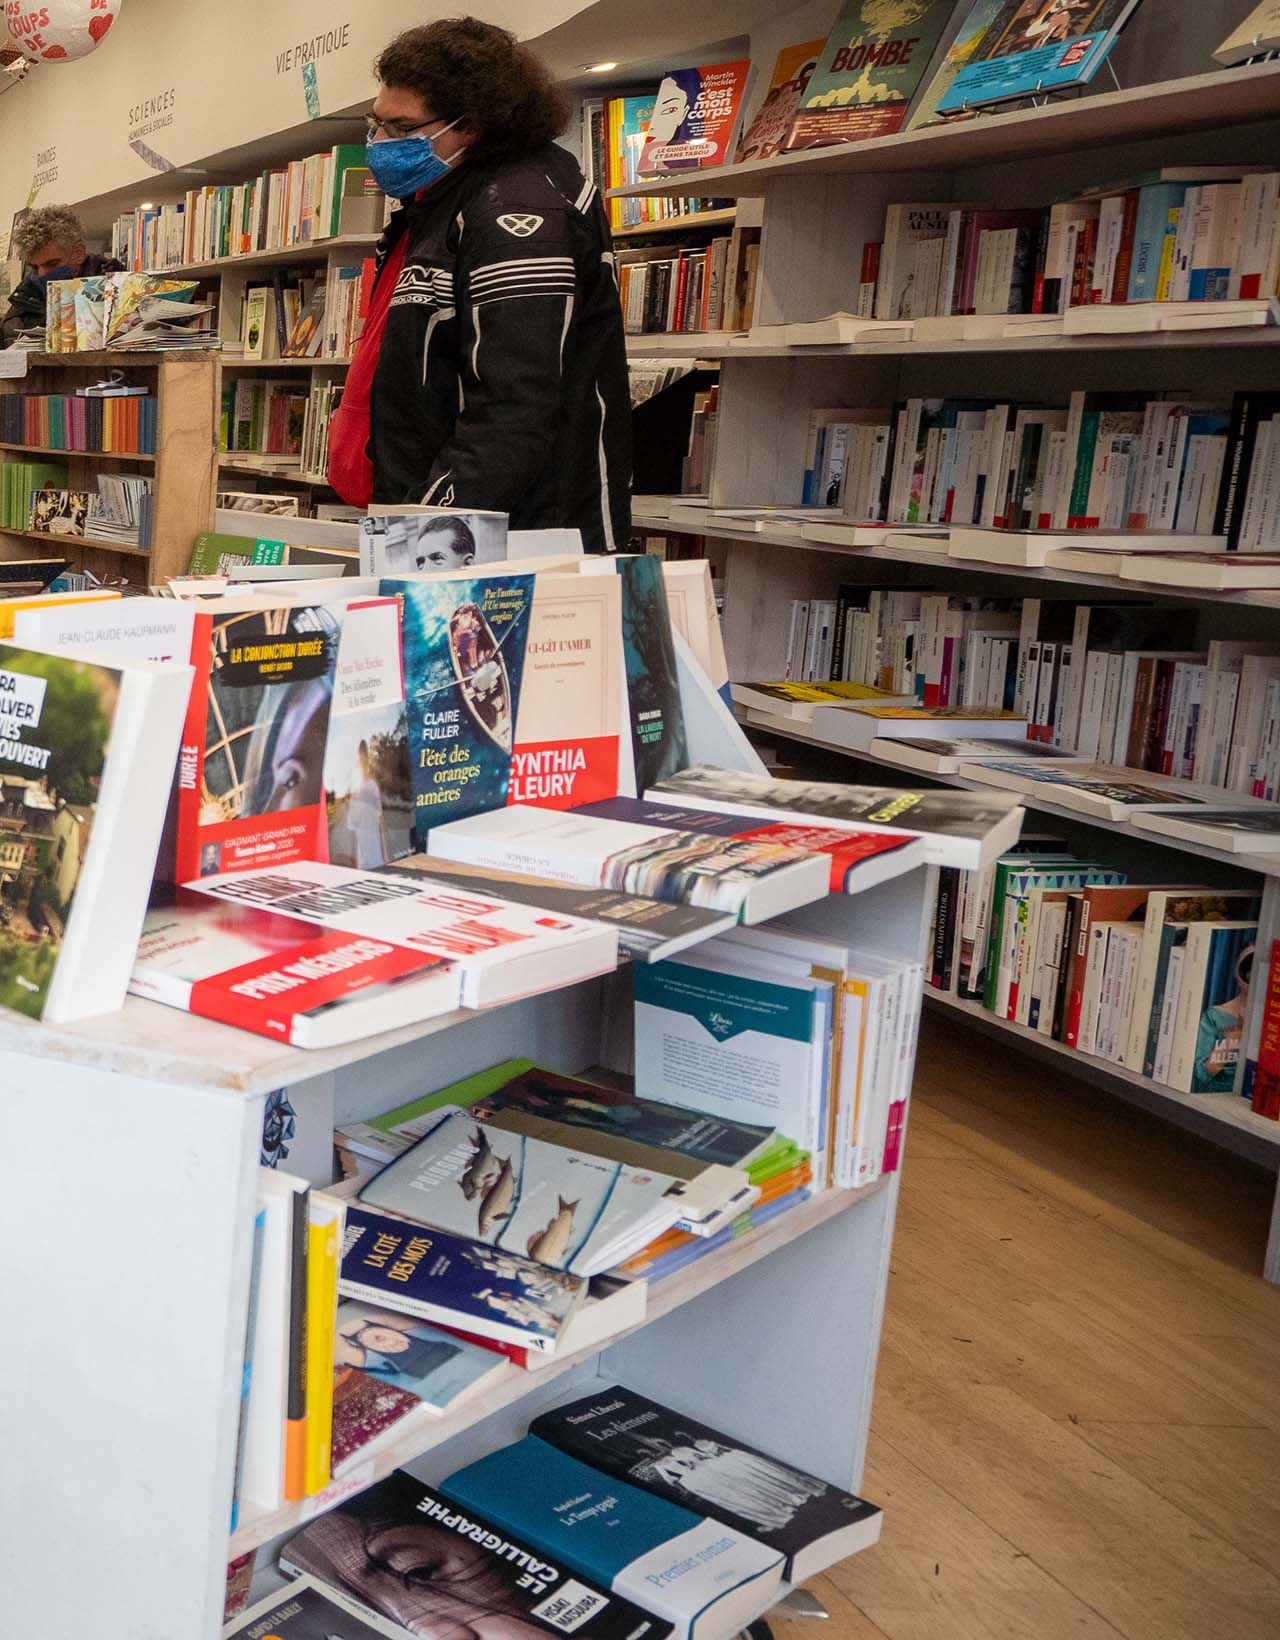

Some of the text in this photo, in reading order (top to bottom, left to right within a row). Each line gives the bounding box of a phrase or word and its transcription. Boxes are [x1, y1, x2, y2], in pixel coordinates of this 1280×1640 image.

[7, 8, 50, 39] COUPS
[23, 34, 47, 51] DE
[275, 24, 350, 74] VIE PRATIQUE
[829, 38, 921, 73] BOMBE
[699, 77, 738, 89] Winckler
[705, 71, 734, 83] Martin
[694, 98, 731, 109] mon
[697, 87, 732, 101] c'est
[128, 88, 175, 126] SCIENCES
[687, 105, 733, 120] corps
[681, 149, 710, 157] TABOU
[689, 143, 710, 151] UTILE
[490, 612, 514, 625] anglais
[57, 623, 178, 647] JEAN-CLAUDE KAUFMANN
[559, 638, 592, 652] L'AMER
[230, 647, 243, 663] LA
[244, 642, 297, 663] CONJONCTION
[424, 709, 460, 726] CLAIRE
[423, 724, 460, 741] FULLER
[419, 746, 470, 768] l'été des
[433, 764, 480, 785] oranges
[416, 785, 461, 808] amères
[225, 824, 308, 849] GAGNANT GRAND PRIX
[229, 940, 394, 1000] PRIX MÉDICIS
[363, 1231, 402, 1270] LA CITÉ
[388, 1237, 434, 1282] DES MOTS
[566, 1400, 626, 1426] Simon Liberati
[587, 1409, 660, 1443] Les démons
[416, 1496, 561, 1584] CALLIGRAPHE
[645, 1535, 738, 1590] Premier roman
[517, 1574, 547, 1595] LE
[540, 1597, 571, 1622] HISAKI
[552, 1593, 600, 1632] MATSUURA
[247, 1621, 271, 1640] DAVID
[268, 1615, 280, 1629] LE
